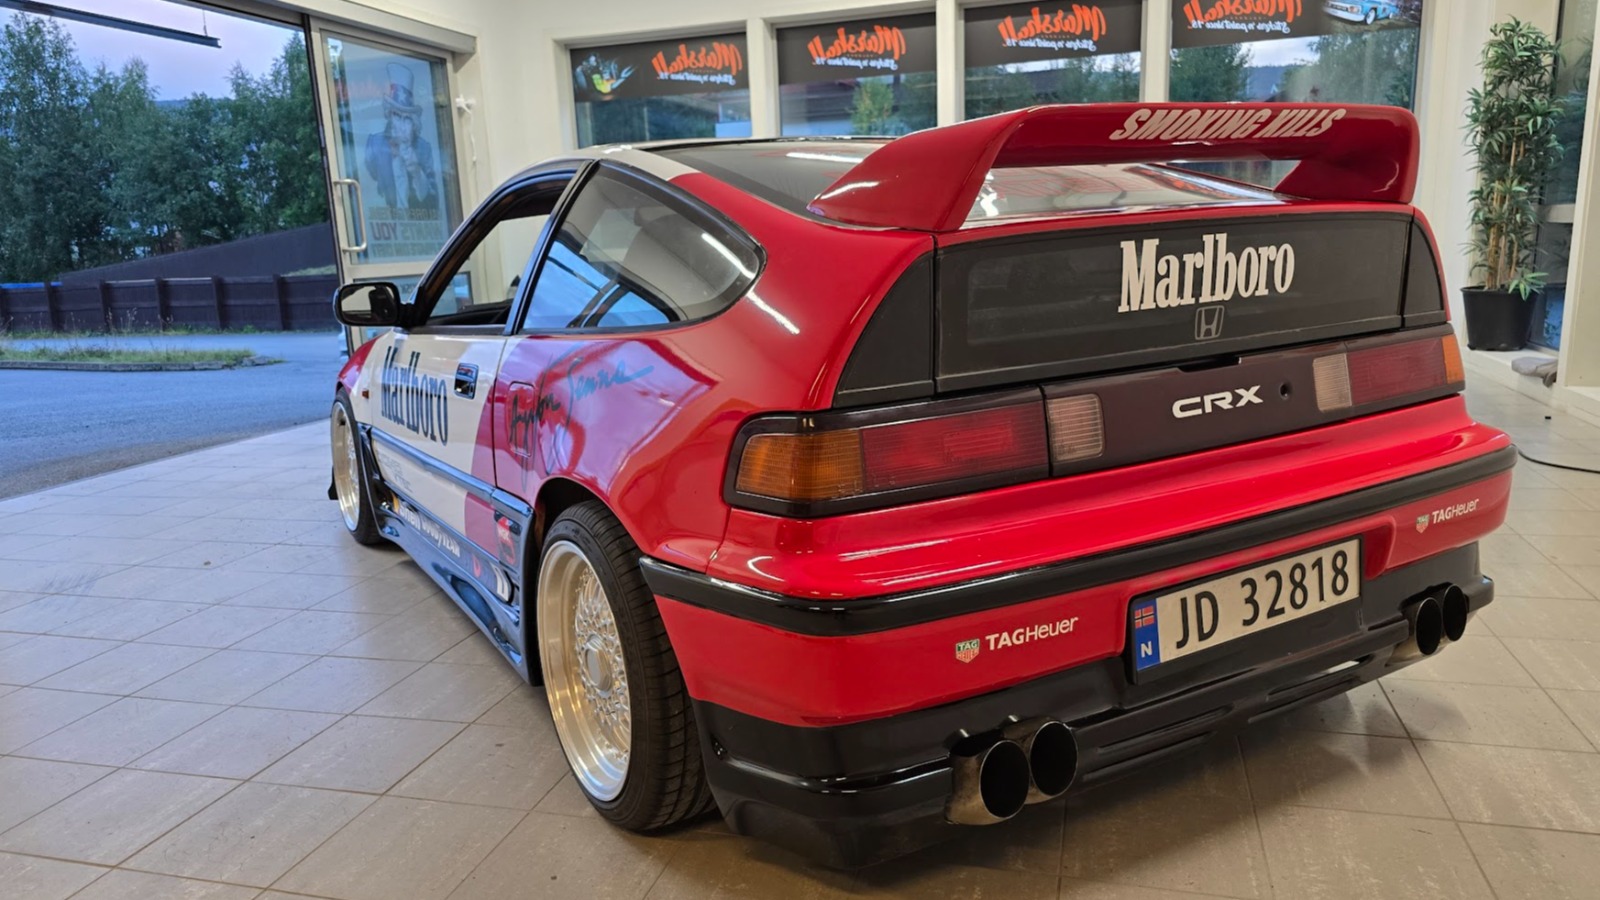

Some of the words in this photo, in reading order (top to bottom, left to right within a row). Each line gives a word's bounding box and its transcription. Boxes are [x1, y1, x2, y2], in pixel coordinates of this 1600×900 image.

[1108, 108, 1273, 141] SMOKING
[1251, 108, 1347, 139] KILLS
[1117, 233, 1296, 314] Marlboro
[381, 345, 449, 447] Marlboro
[1171, 385, 1264, 419] CRX
[1176, 590, 1220, 650] JD
[1240, 549, 1350, 627] 32818
[958, 640, 979, 652] TAG
[1140, 640, 1153, 658] N
